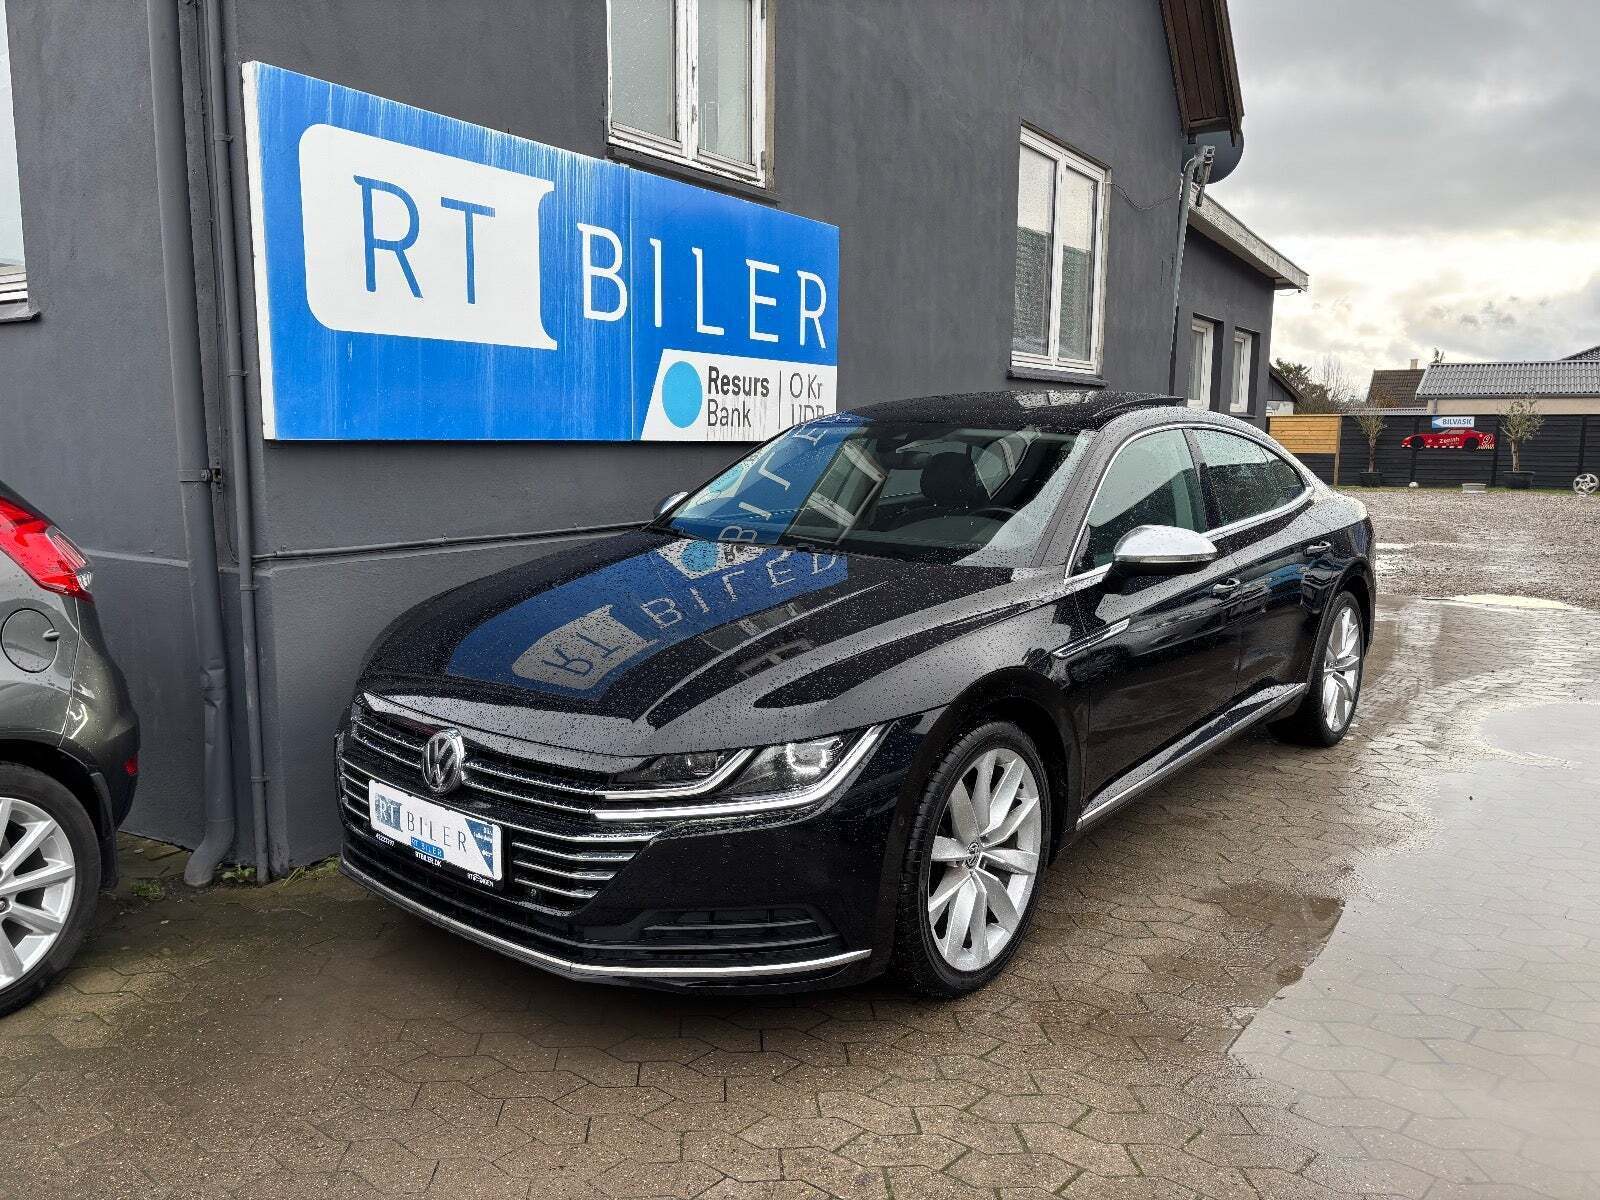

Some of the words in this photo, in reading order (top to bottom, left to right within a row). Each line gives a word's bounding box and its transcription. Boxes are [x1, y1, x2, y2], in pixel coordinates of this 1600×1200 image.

[353, 175, 496, 305] RT
[576, 222, 828, 350] BILER
[707, 365, 770, 398] Resurs
[807, 373, 823, 400] Kr
[707, 398, 752, 428] Bank
[1442, 418, 1472, 426] BILVASK
[379, 801, 398, 823] RT
[406, 810, 467, 855] BILER
